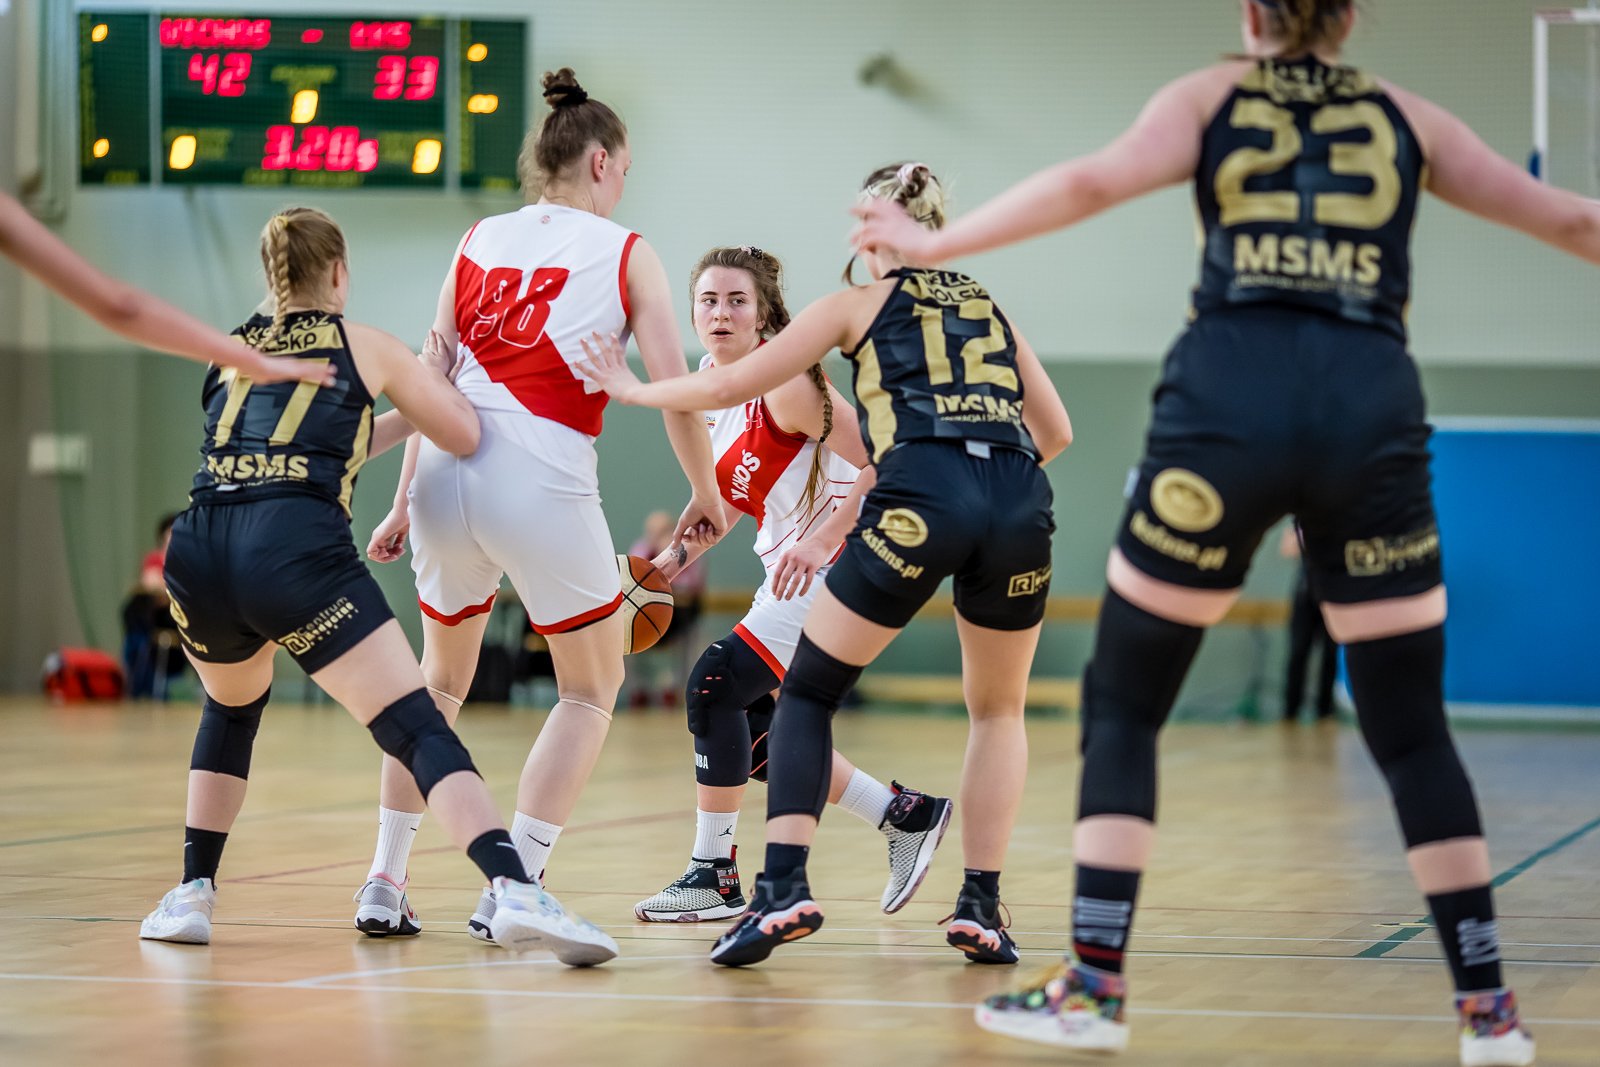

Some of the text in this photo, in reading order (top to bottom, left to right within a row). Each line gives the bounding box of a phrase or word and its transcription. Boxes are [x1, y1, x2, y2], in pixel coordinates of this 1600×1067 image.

[188, 52, 252, 97] 42
[372, 55, 440, 100] 33
[1213, 97, 1402, 230] 23
[1233, 233, 1382, 285] MSMS
[912, 298, 1018, 392] 12
[213, 357, 330, 447] 77
[207, 453, 309, 480] MSMS
